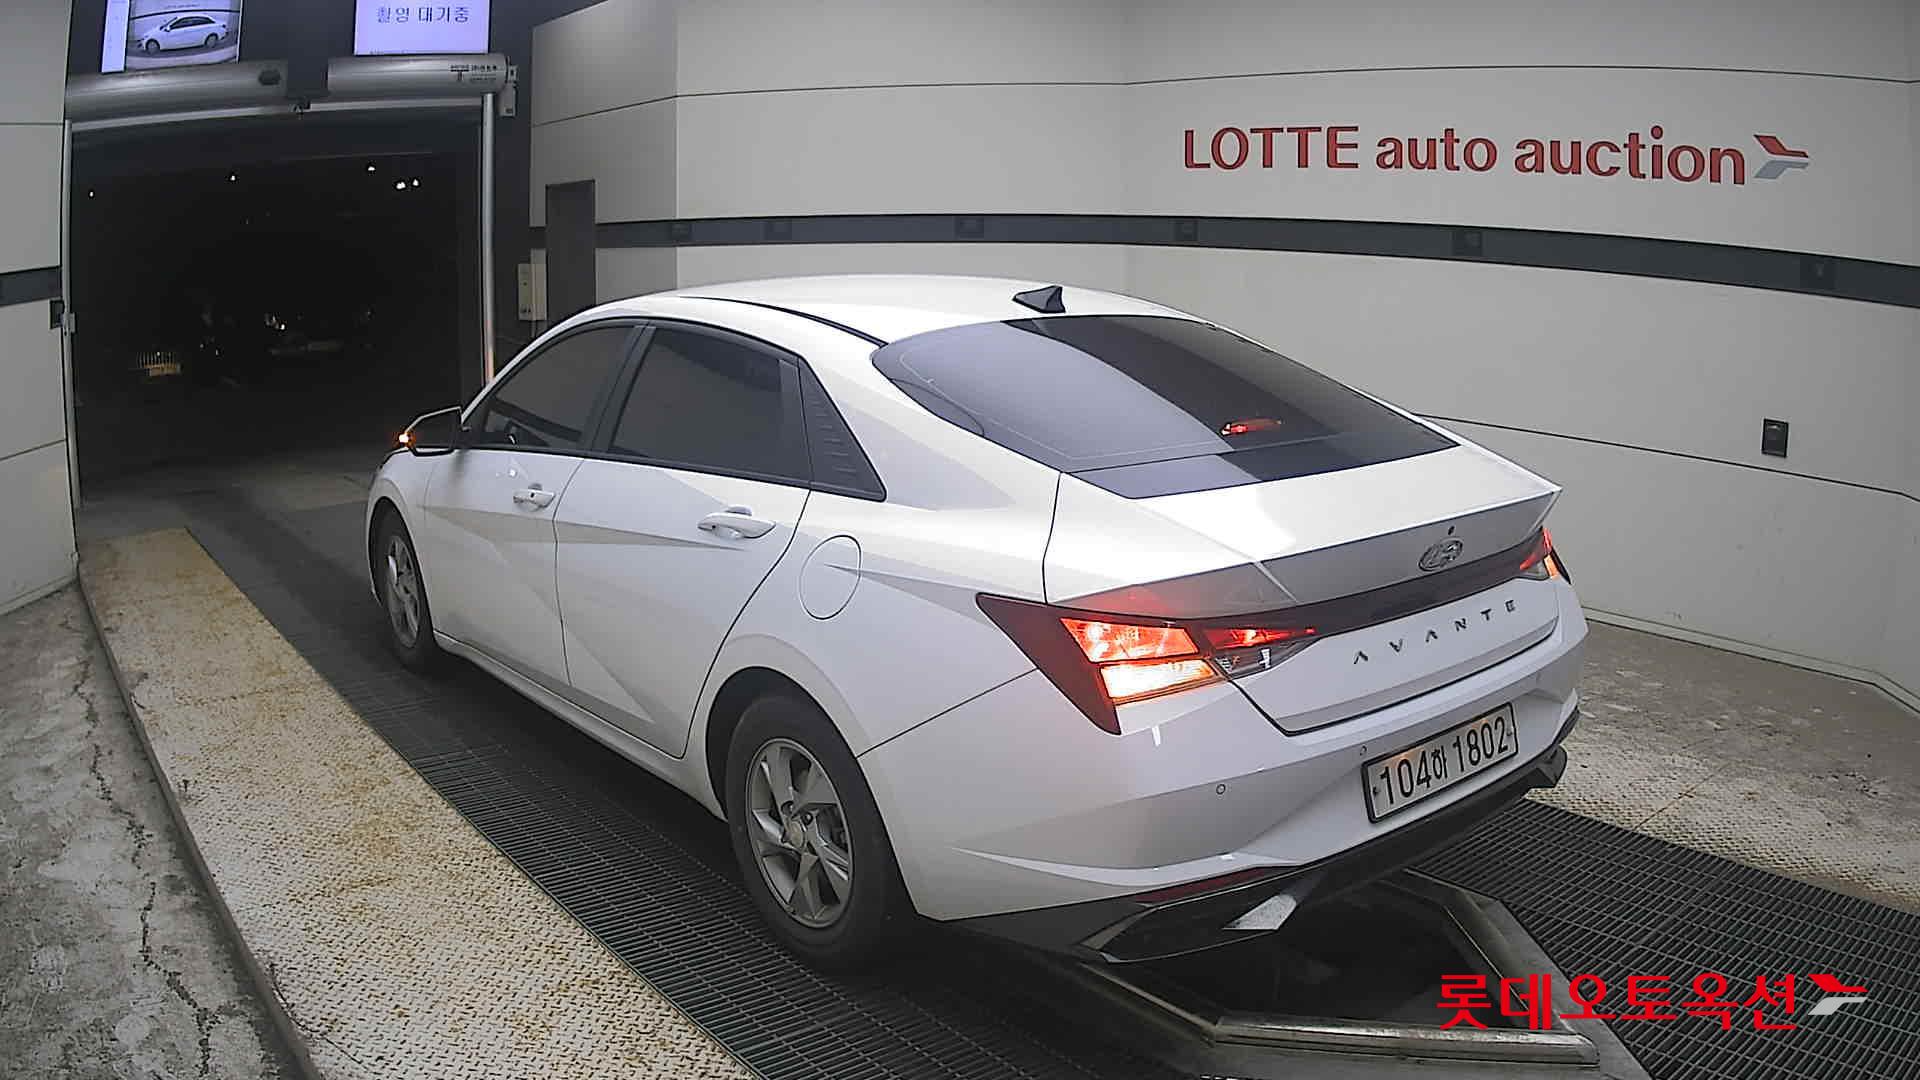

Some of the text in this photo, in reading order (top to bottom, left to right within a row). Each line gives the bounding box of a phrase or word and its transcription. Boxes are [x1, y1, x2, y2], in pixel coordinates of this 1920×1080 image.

[418, 6, 469, 23] 대기중
[1184, 125, 1745, 185] LOTTE auto auction
[1353, 600, 1516, 665] AVANTE
